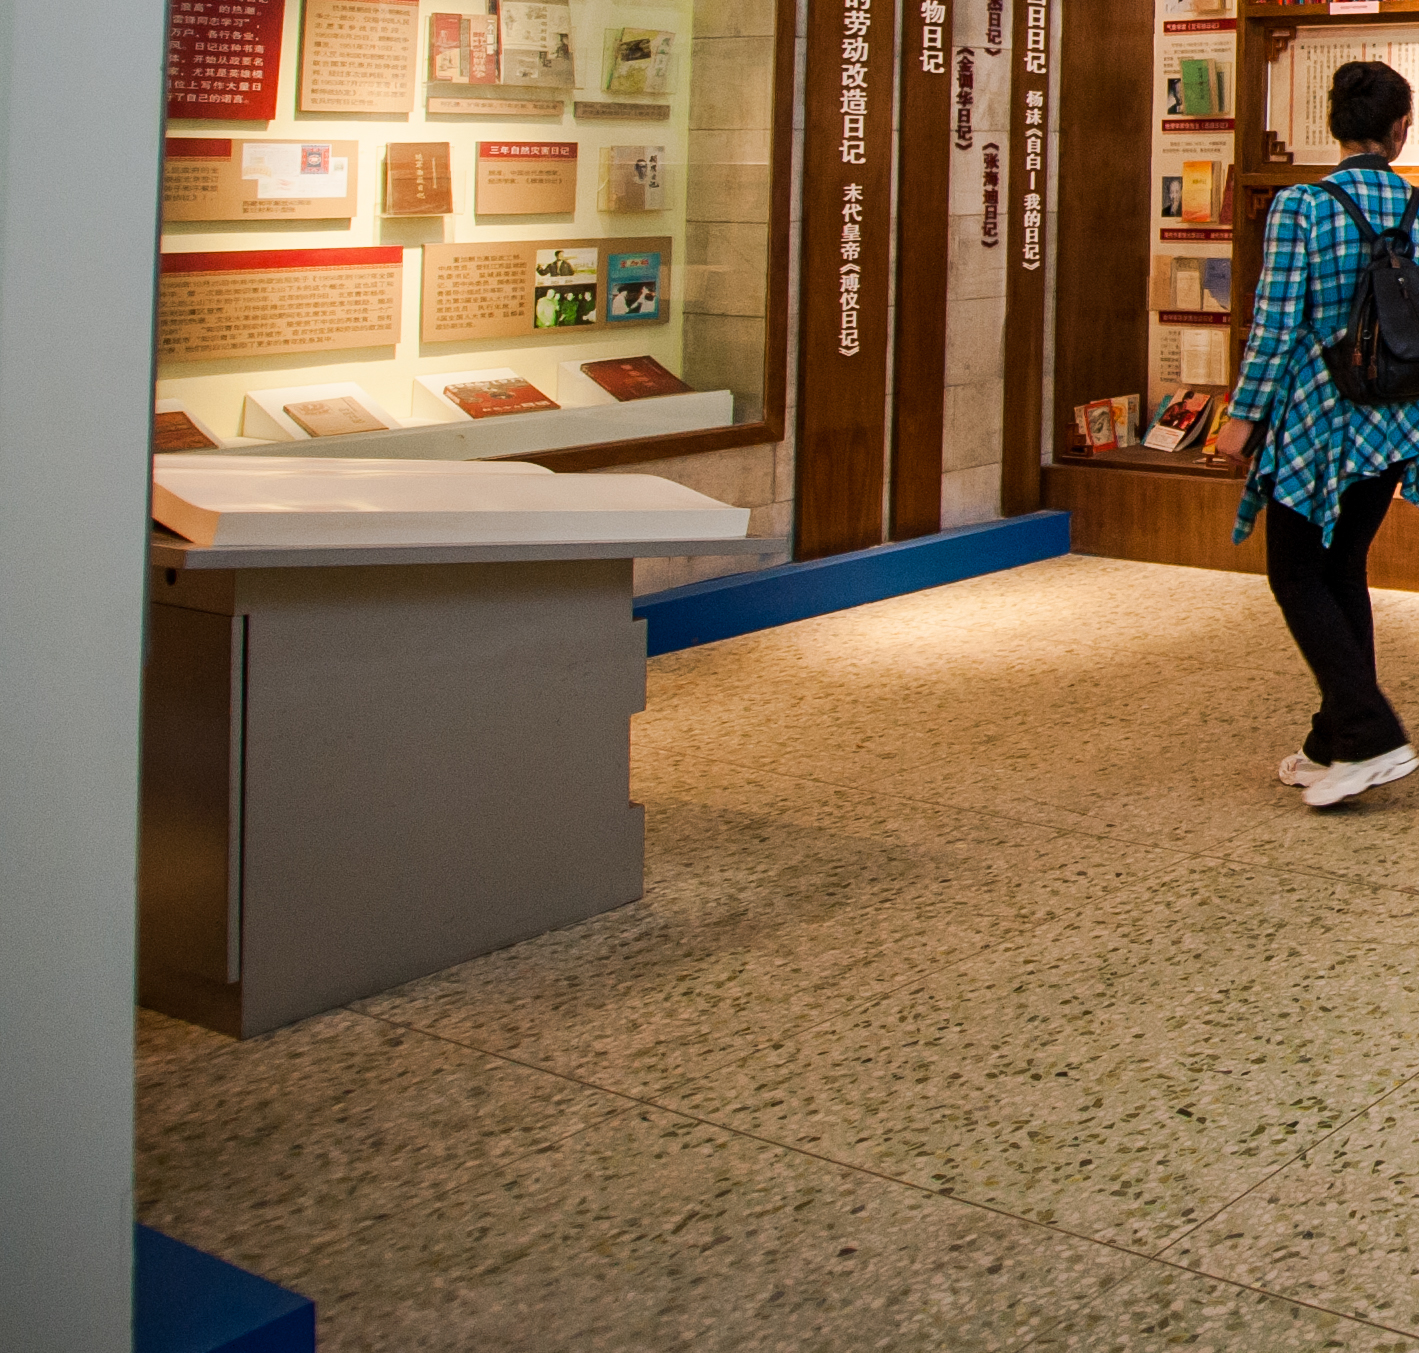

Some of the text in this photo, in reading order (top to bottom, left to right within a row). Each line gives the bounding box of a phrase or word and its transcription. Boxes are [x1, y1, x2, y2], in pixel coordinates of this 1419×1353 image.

[489, 145, 571, 156] 三年自然灾害日记
[954, 46, 975, 151] 《金训华日记》
[981, 142, 1000, 248] 《张海迪日记》
[839, 182, 864, 357] 末代皇帝《溥仪日记》
